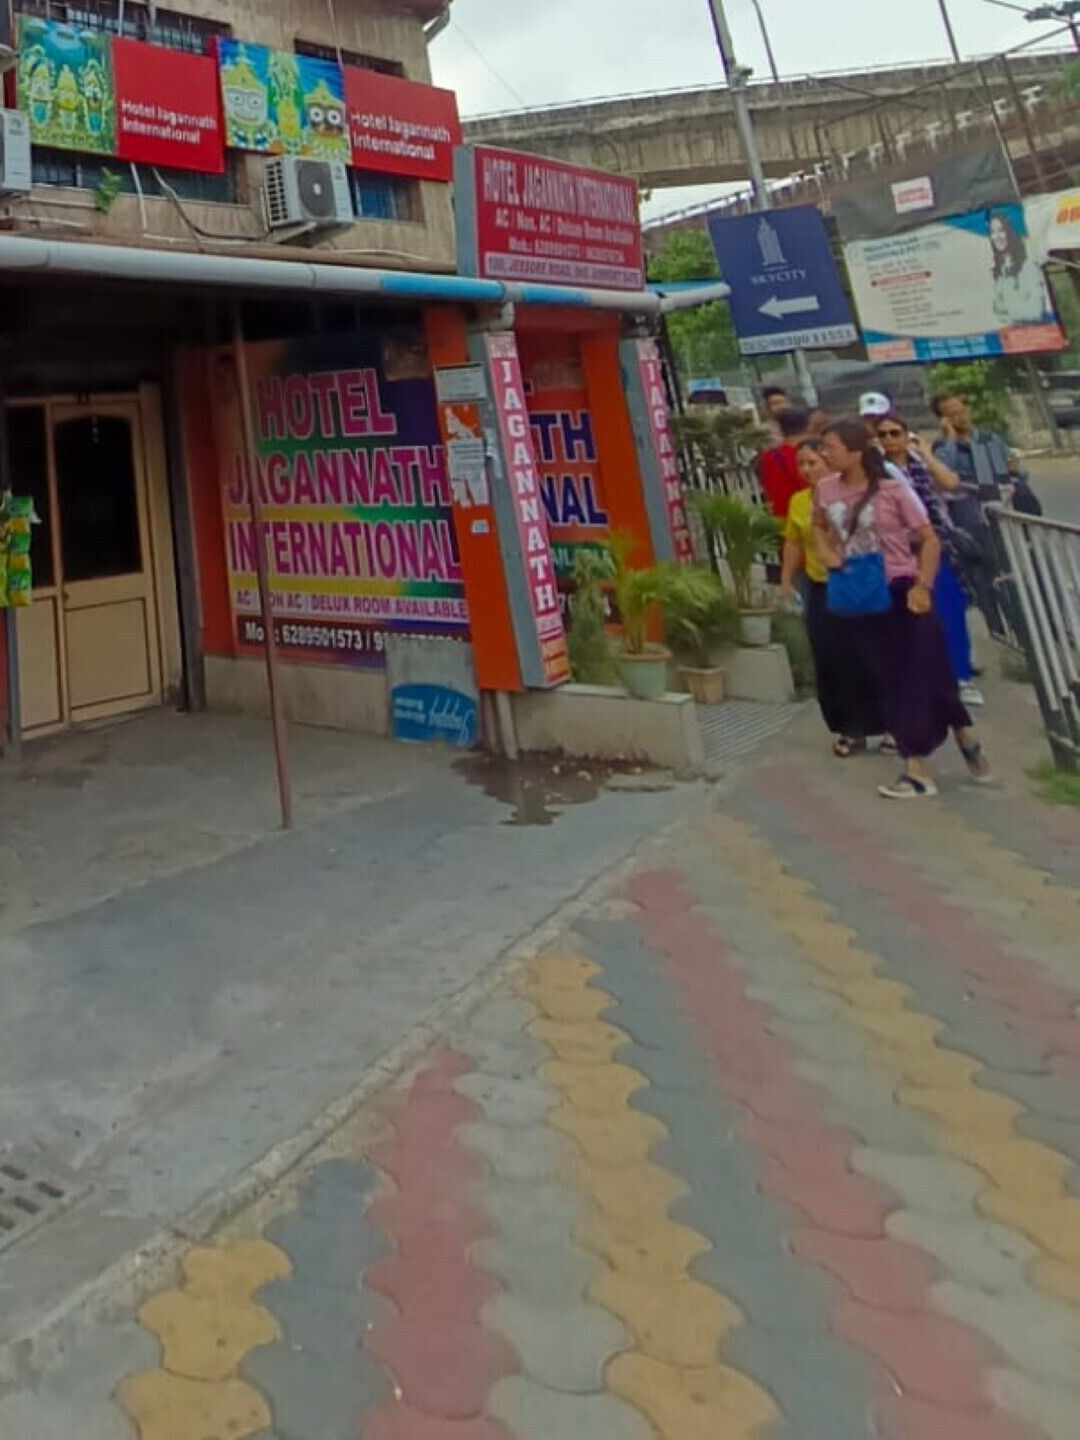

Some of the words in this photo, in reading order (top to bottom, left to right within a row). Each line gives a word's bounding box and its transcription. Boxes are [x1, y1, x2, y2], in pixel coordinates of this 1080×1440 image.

[122, 99, 156, 119] Hotel
[157, 107, 217, 130] Jagannath
[351, 110, 387, 131] Hotel
[388, 115, 451, 143] Jagannath
[123, 117, 201, 145] International
[352, 129, 435, 161] International
[483, 157, 520, 206] HOTEL
[749, 267, 807, 286] SKYCITY
[257, 368, 398, 441] HOTEL
[236, 590, 251, 606] AC
[287, 592, 303, 609] AC
[312, 594, 350, 613] DELUX
[352, 596, 390, 615] ROOM
[394, 598, 468, 619] AVAILABLE
